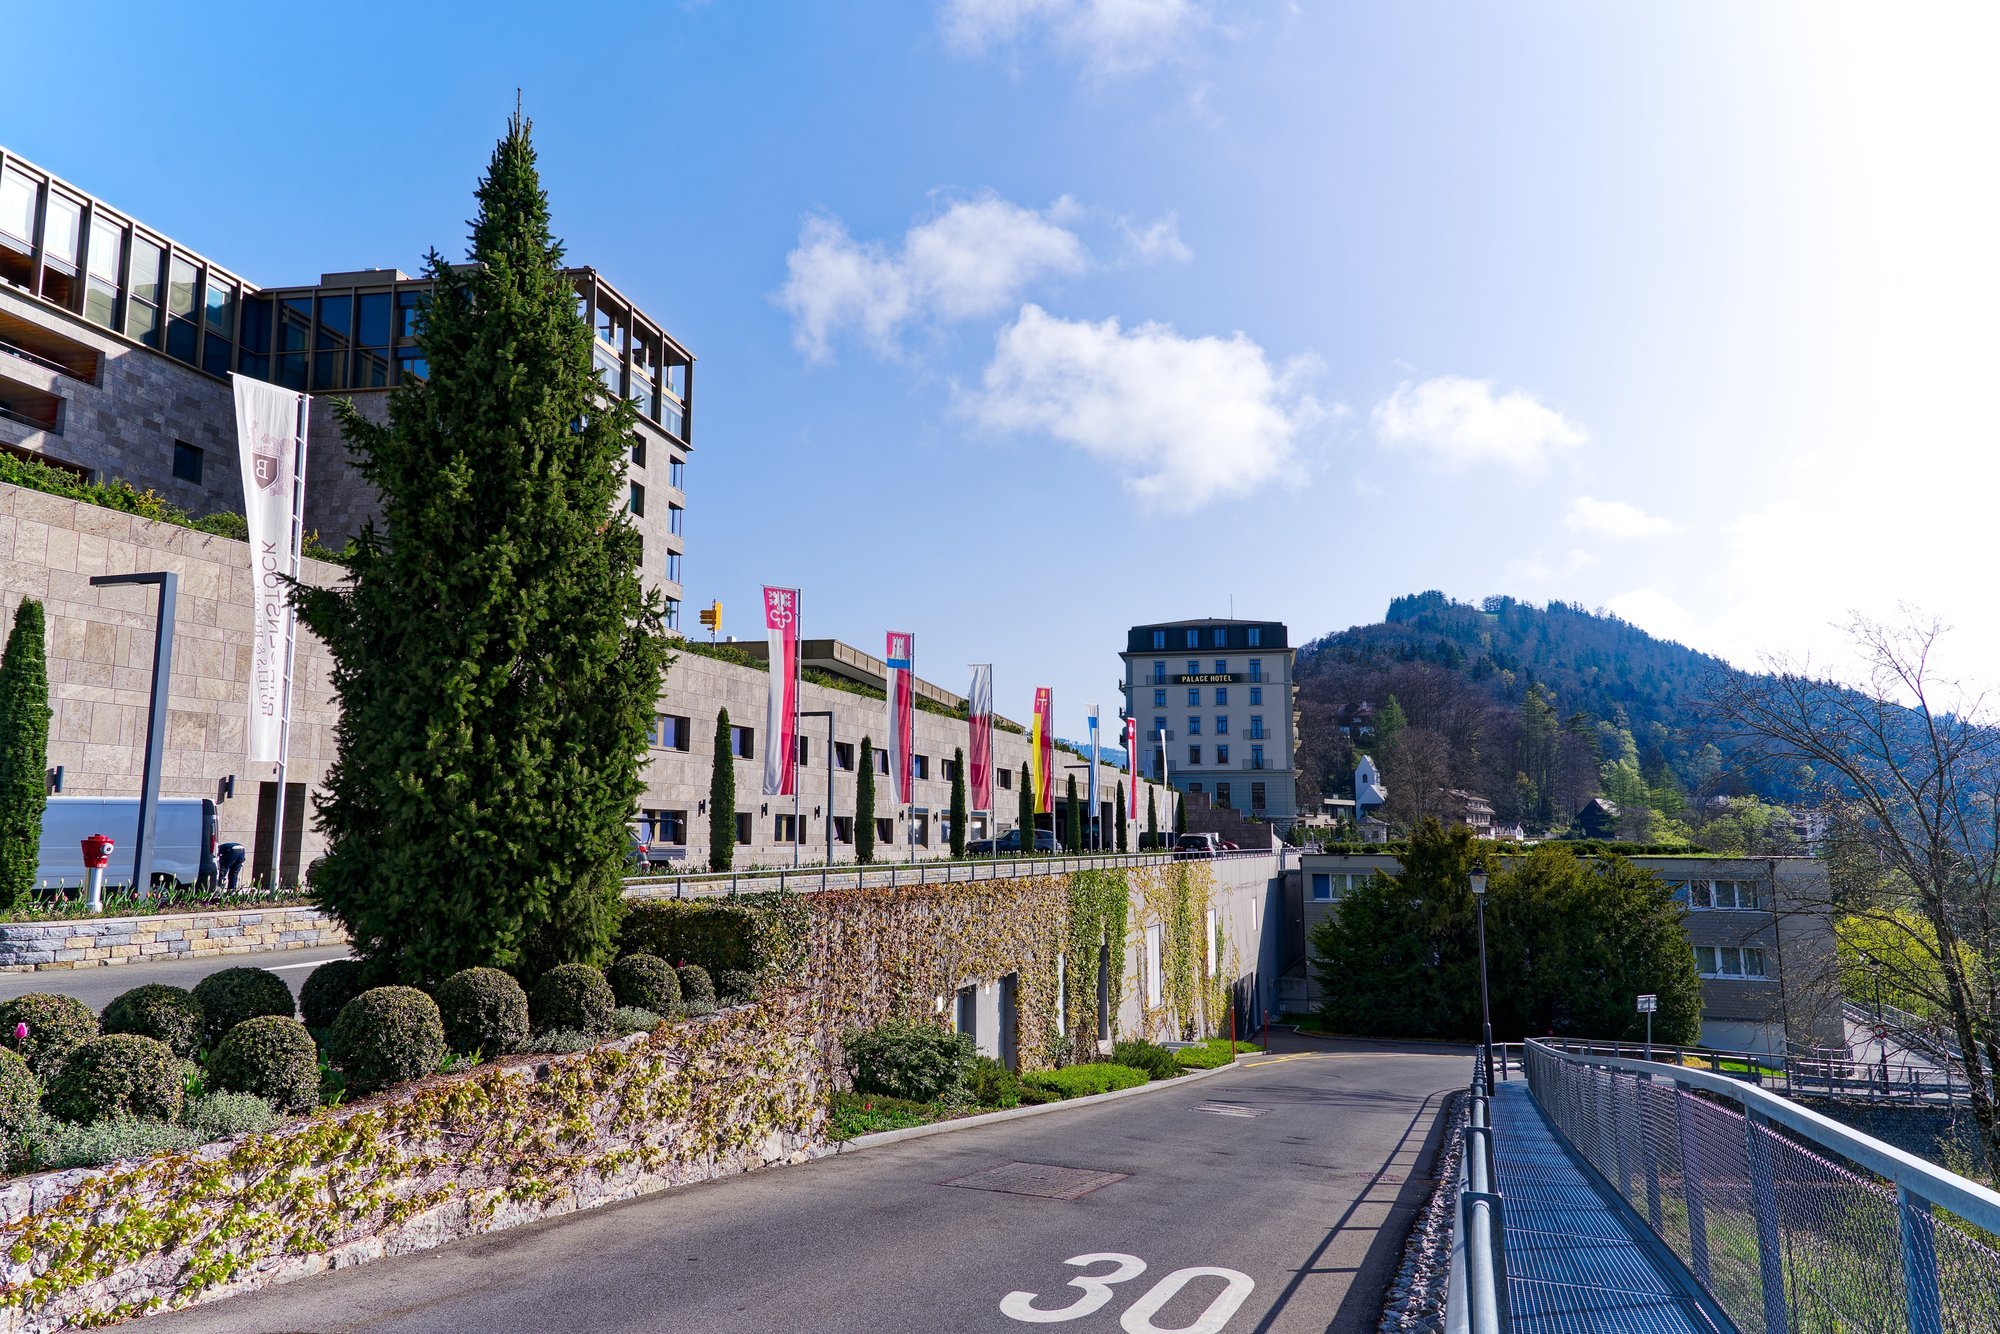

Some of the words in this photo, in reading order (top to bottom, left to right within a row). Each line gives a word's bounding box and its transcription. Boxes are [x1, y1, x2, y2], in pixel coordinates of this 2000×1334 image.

[1181, 675, 1208, 683] PALACE
[1210, 674, 1233, 682] HOTEL
[1000, 1252, 1255, 1334] 30
